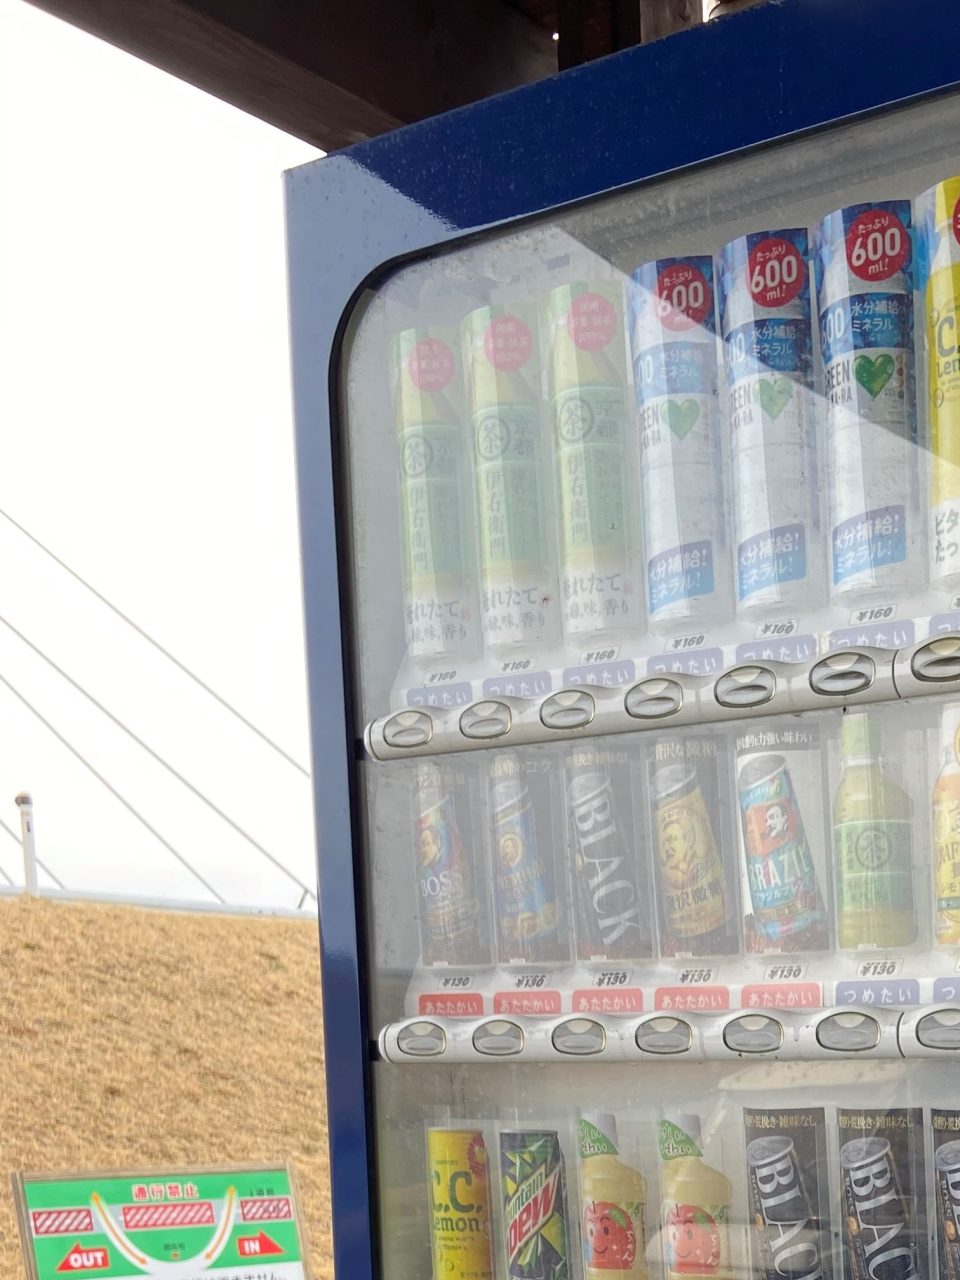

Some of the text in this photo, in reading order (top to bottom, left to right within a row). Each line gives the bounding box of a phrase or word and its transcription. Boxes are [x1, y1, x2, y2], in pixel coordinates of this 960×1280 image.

[858, 216, 889, 234] たっぷり
[756, 244, 786, 262] たっぷり
[852, 227, 900, 267] 600
[751, 255, 798, 294] 600
[868, 258, 889, 275] ml!
[658, 280, 705, 318] 600
[850, 300, 899, 317] 水分補給
[851, 318, 893, 333] ミネラル
[574, 797, 642, 946] BLACK
[860, 963, 896, 976] ¥130
[579, 997, 636, 1011] あたたかい
[662, 995, 722, 1009] あたたかい
[749, 993, 813, 1007] あたたかい
[844, 988, 911, 1003] つめたい
[425, 1001, 478, 1014] あたたかい
[501, 999, 555, 1013] あたたかい
[132, 1182, 199, 1201] 通行禁止
[243, 1239, 261, 1255] IN
[69, 1251, 105, 1269] OUT
